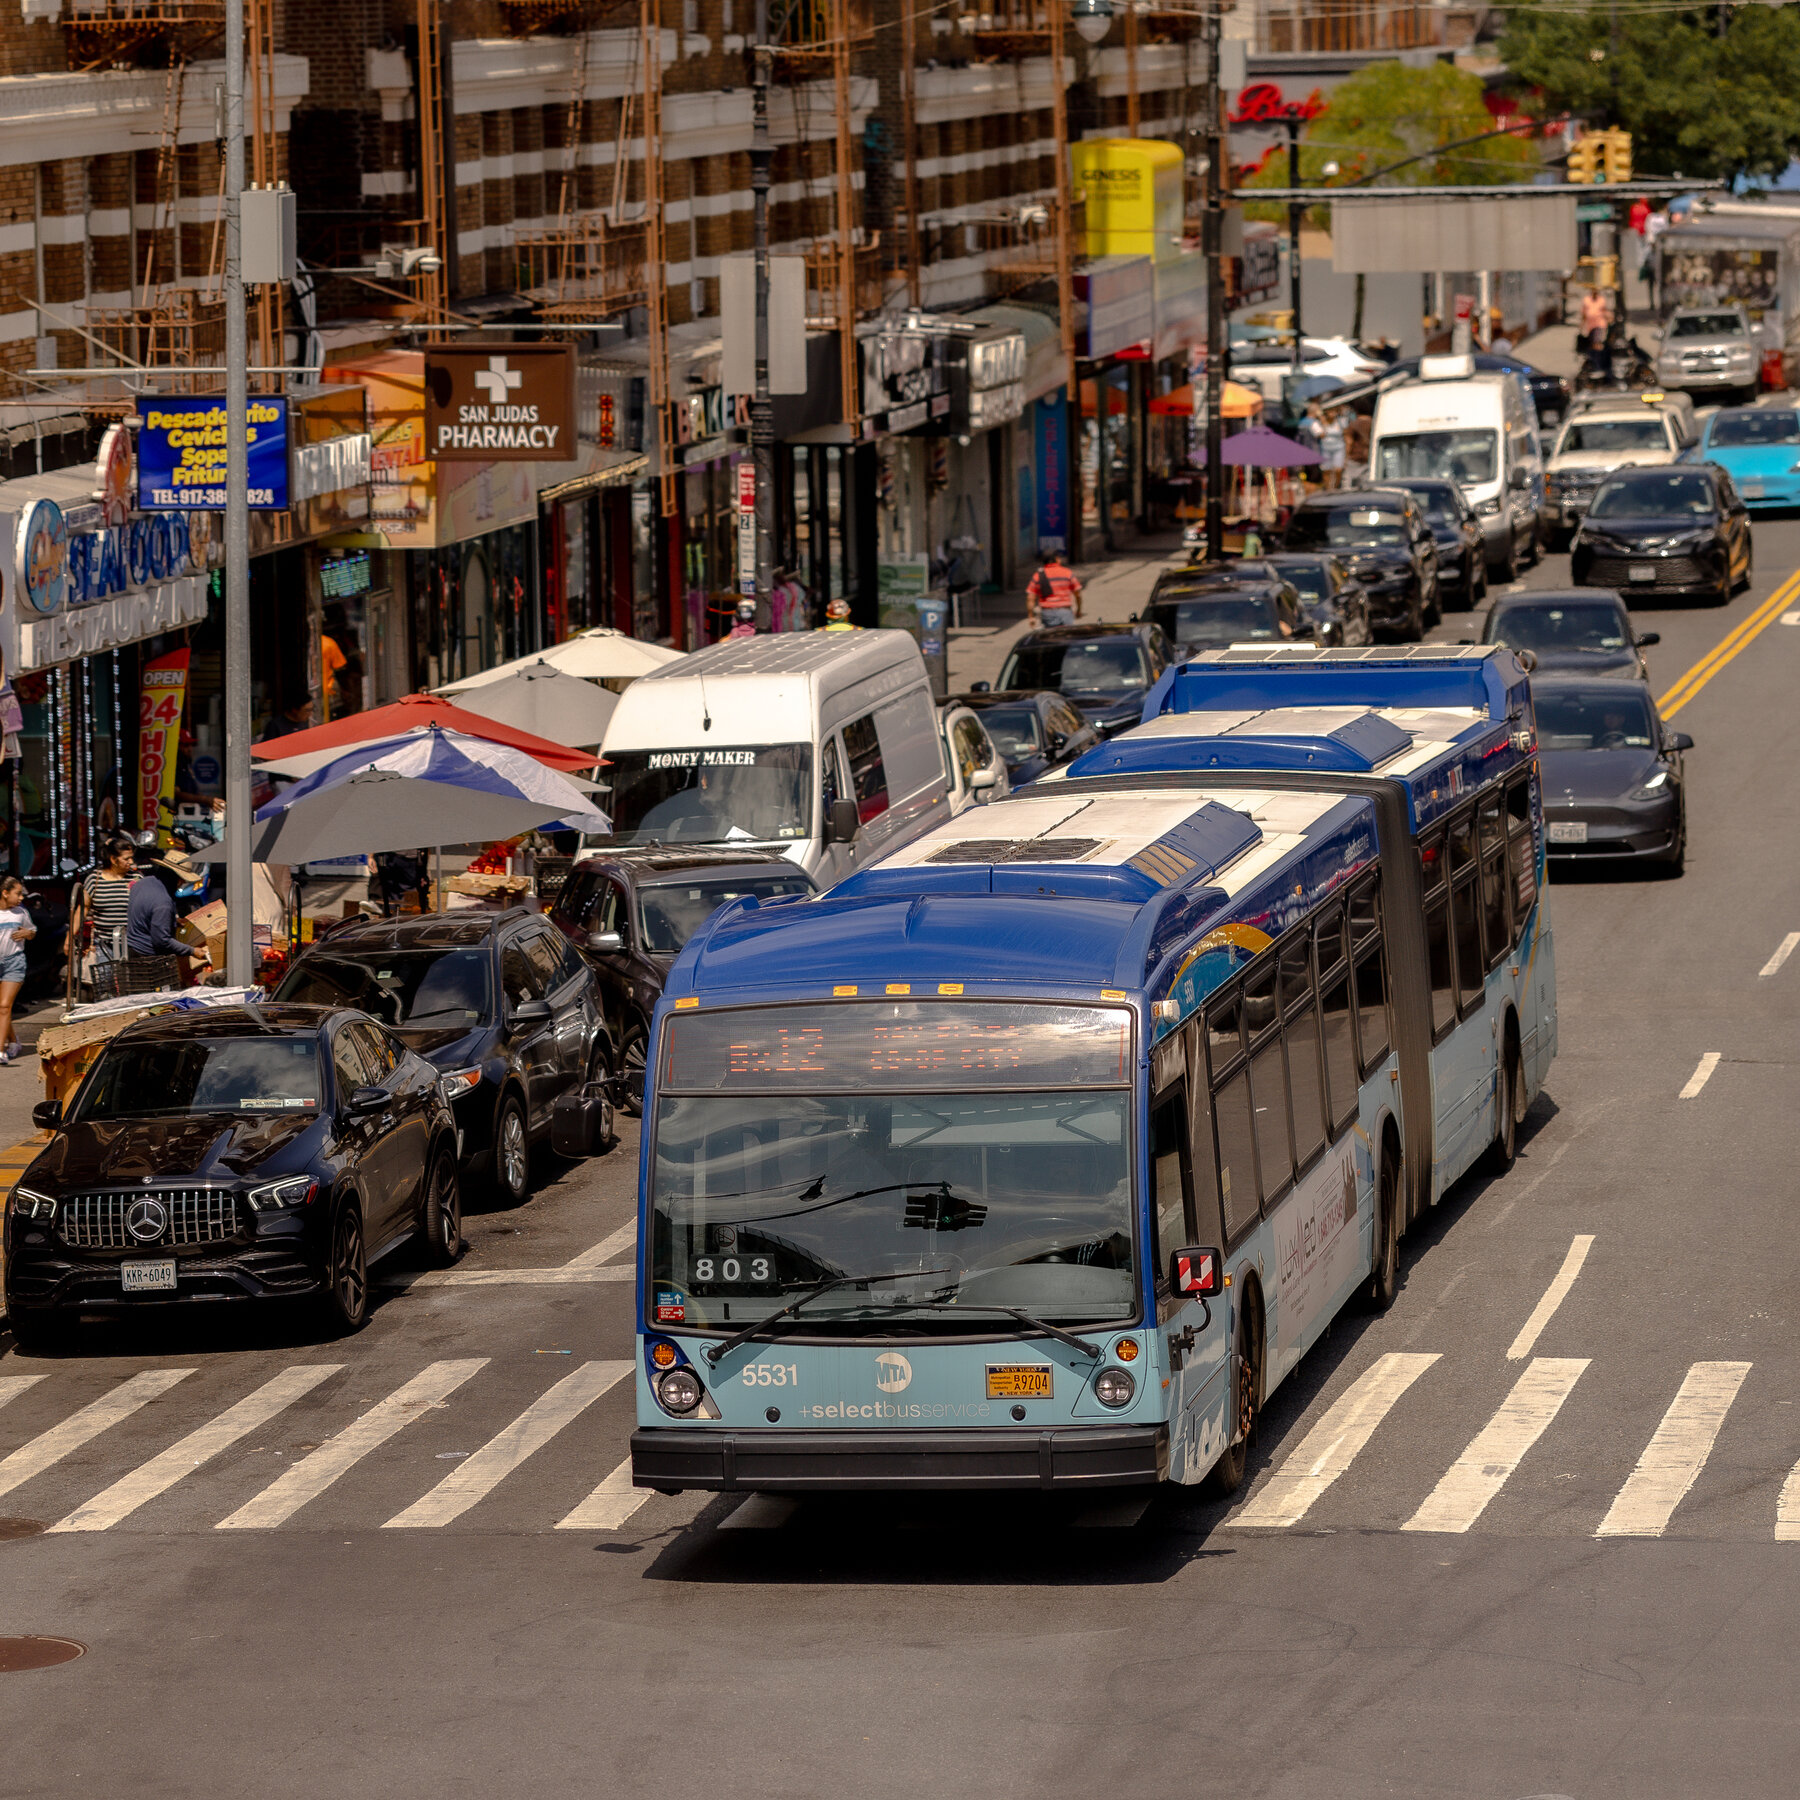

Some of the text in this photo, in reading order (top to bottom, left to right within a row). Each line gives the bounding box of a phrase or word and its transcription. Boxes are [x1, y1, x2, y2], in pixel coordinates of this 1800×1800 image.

[147, 402, 280, 430] Pescado rito
[459, 405, 539, 423] SAN JUDAS
[167, 425, 258, 448] Cevics
[438, 425, 559, 449] PHARMACY
[181, 447, 227, 468] Sopa
[172, 464, 228, 486] Fritur
[152, 489, 178, 505] TEL:
[32, 573, 209, 668] RESTAURANT
[926, 612, 938, 629] P
[144, 671, 184, 686] OPEN
[140, 693, 181, 730] 24
[648, 751, 756, 770] MONEY MAKER
[696, 1258, 769, 1281] 803
[742, 1364, 798, 1387] 5531
[875, 1361, 907, 1385] MTA
[1021, 1374, 1048, 1391] 9204
